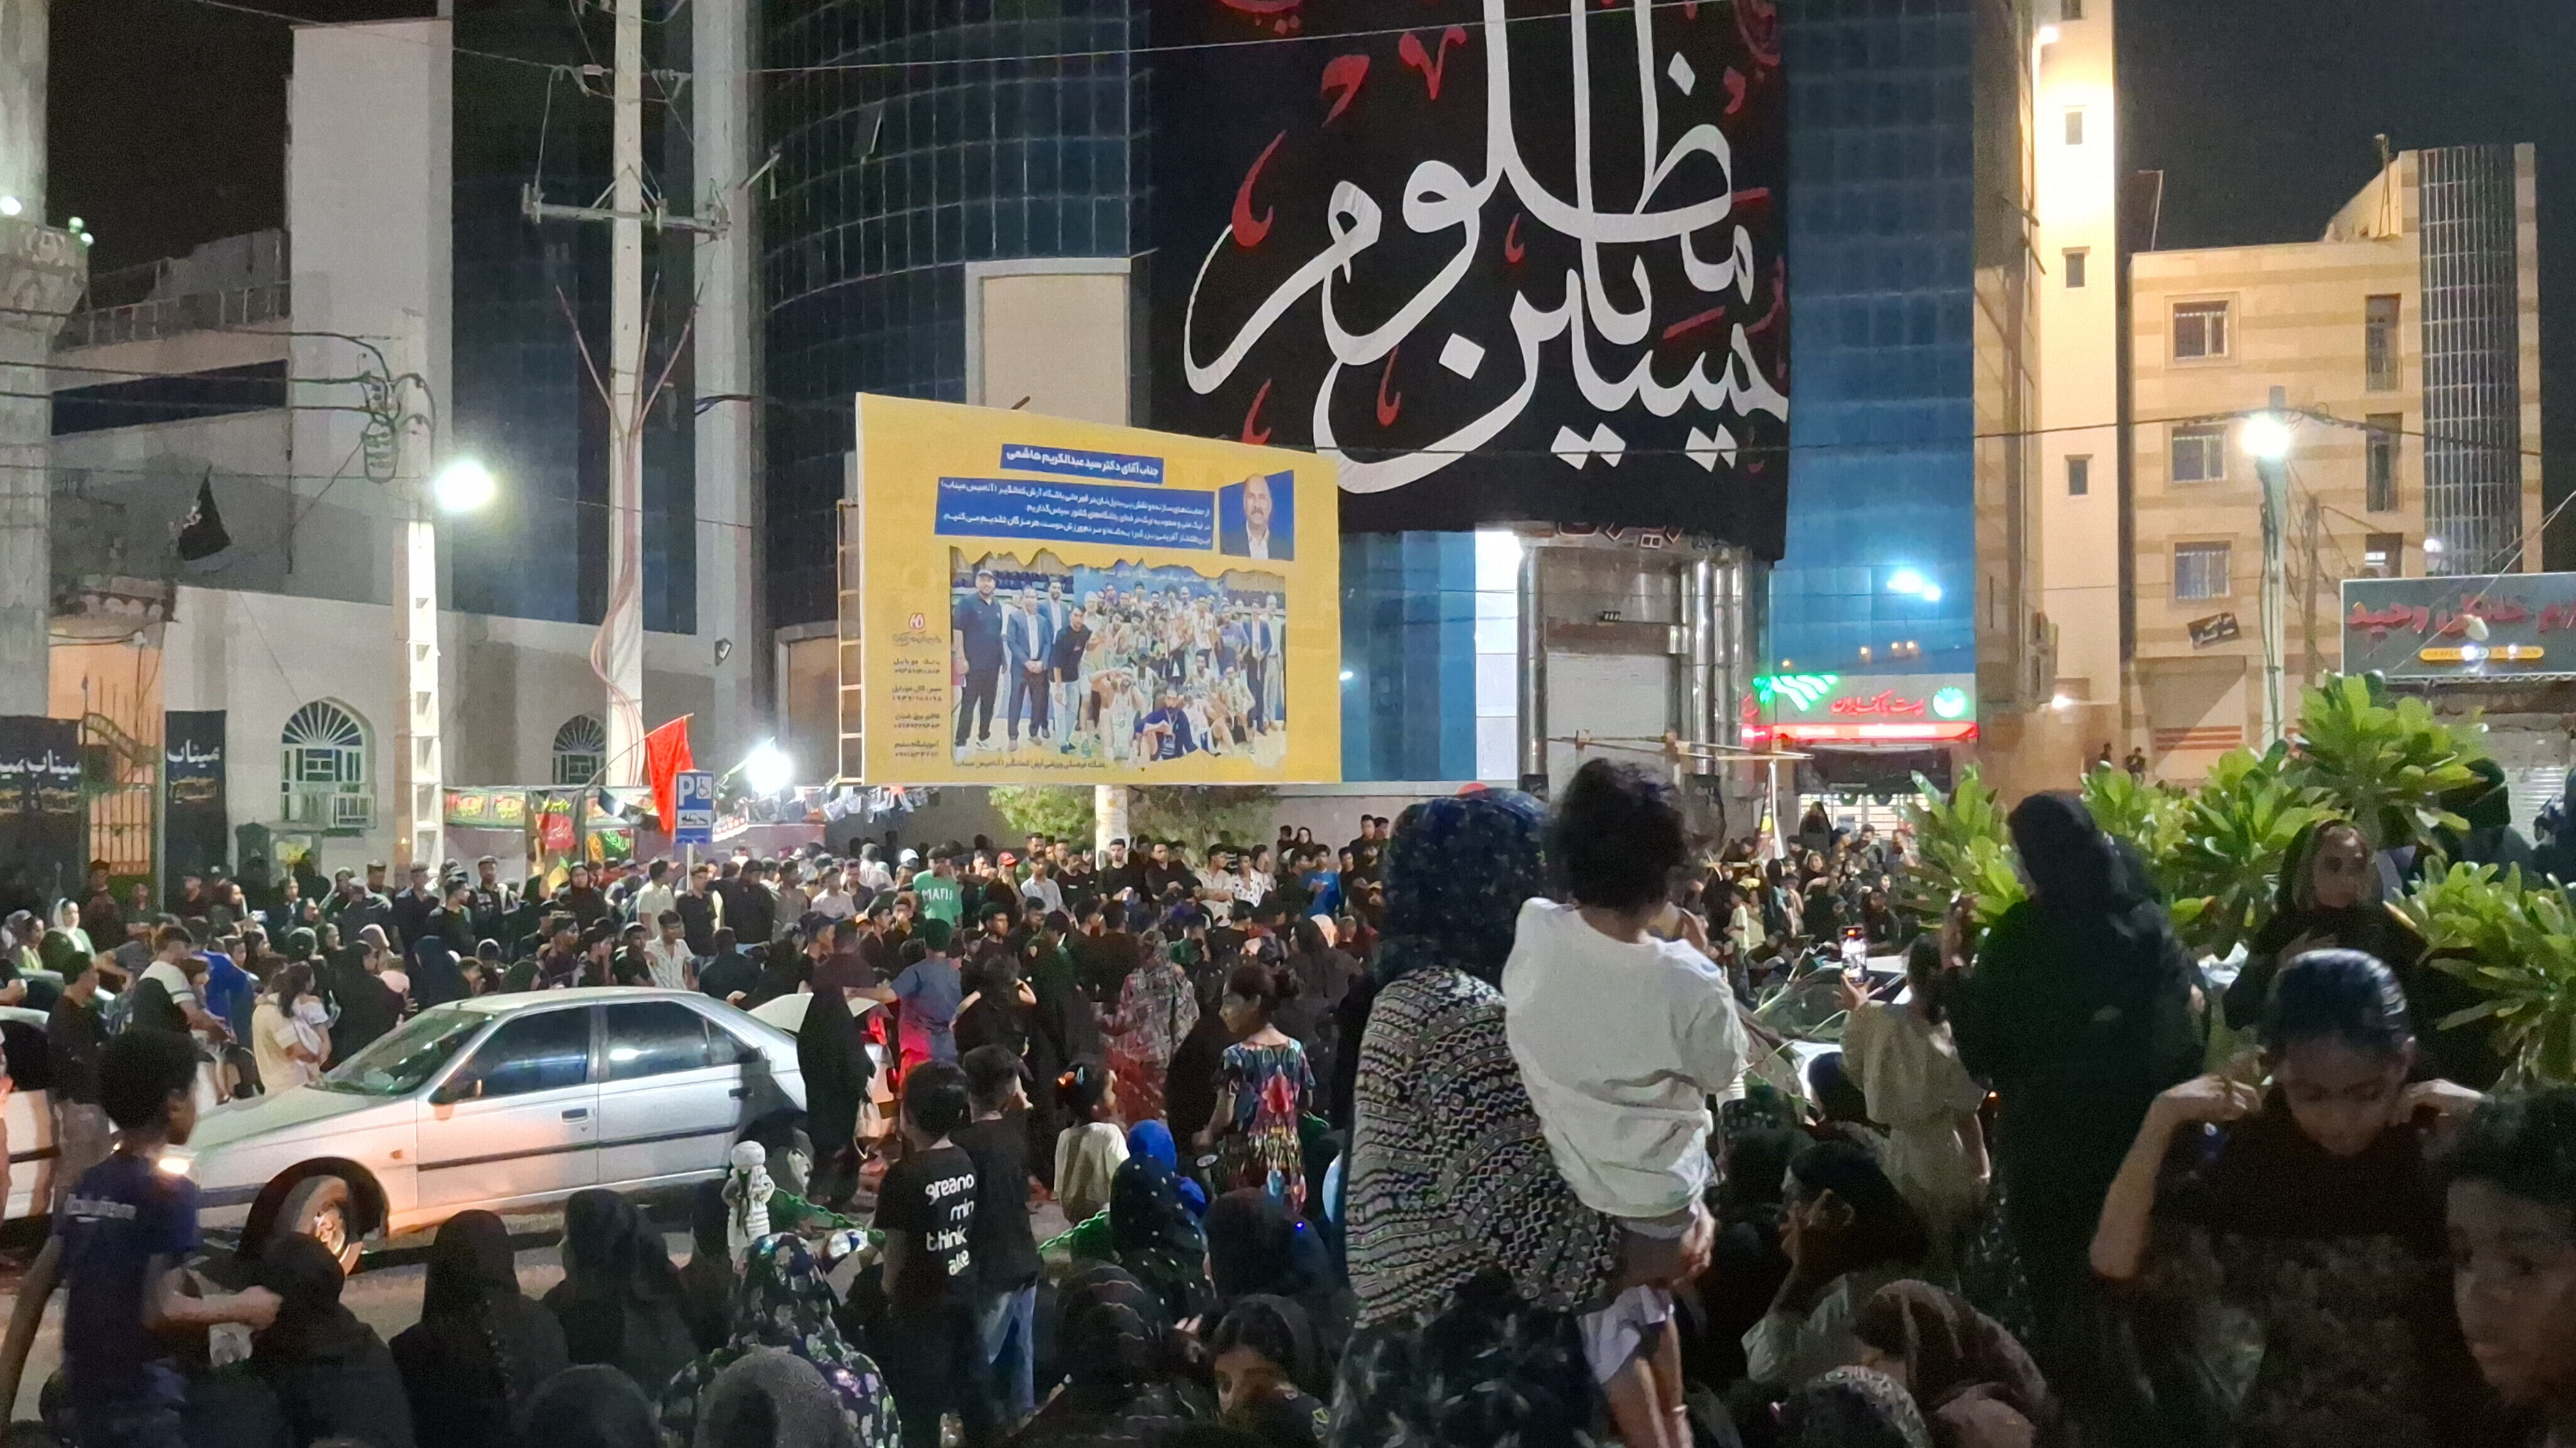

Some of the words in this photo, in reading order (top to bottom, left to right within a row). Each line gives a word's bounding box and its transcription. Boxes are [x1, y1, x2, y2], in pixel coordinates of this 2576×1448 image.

[1007, 447, 1041, 460] هاشمی
[1041, 453, 1085, 468] عبدالکریم
[1085, 458, 1102, 469] سید
[1102, 460, 1121, 472] دکتر
[1121, 461, 1140, 476] آقای
[1140, 464, 1159, 478] جناب
[1041, 489, 1064, 500] باشگاه
[1829, 695, 1864, 716] ایران
[1889, 696, 1925, 716] پست
[167, 739, 219, 769] میناب
[678, 775, 696, 806] P
[926, 1224, 968, 1252] think
